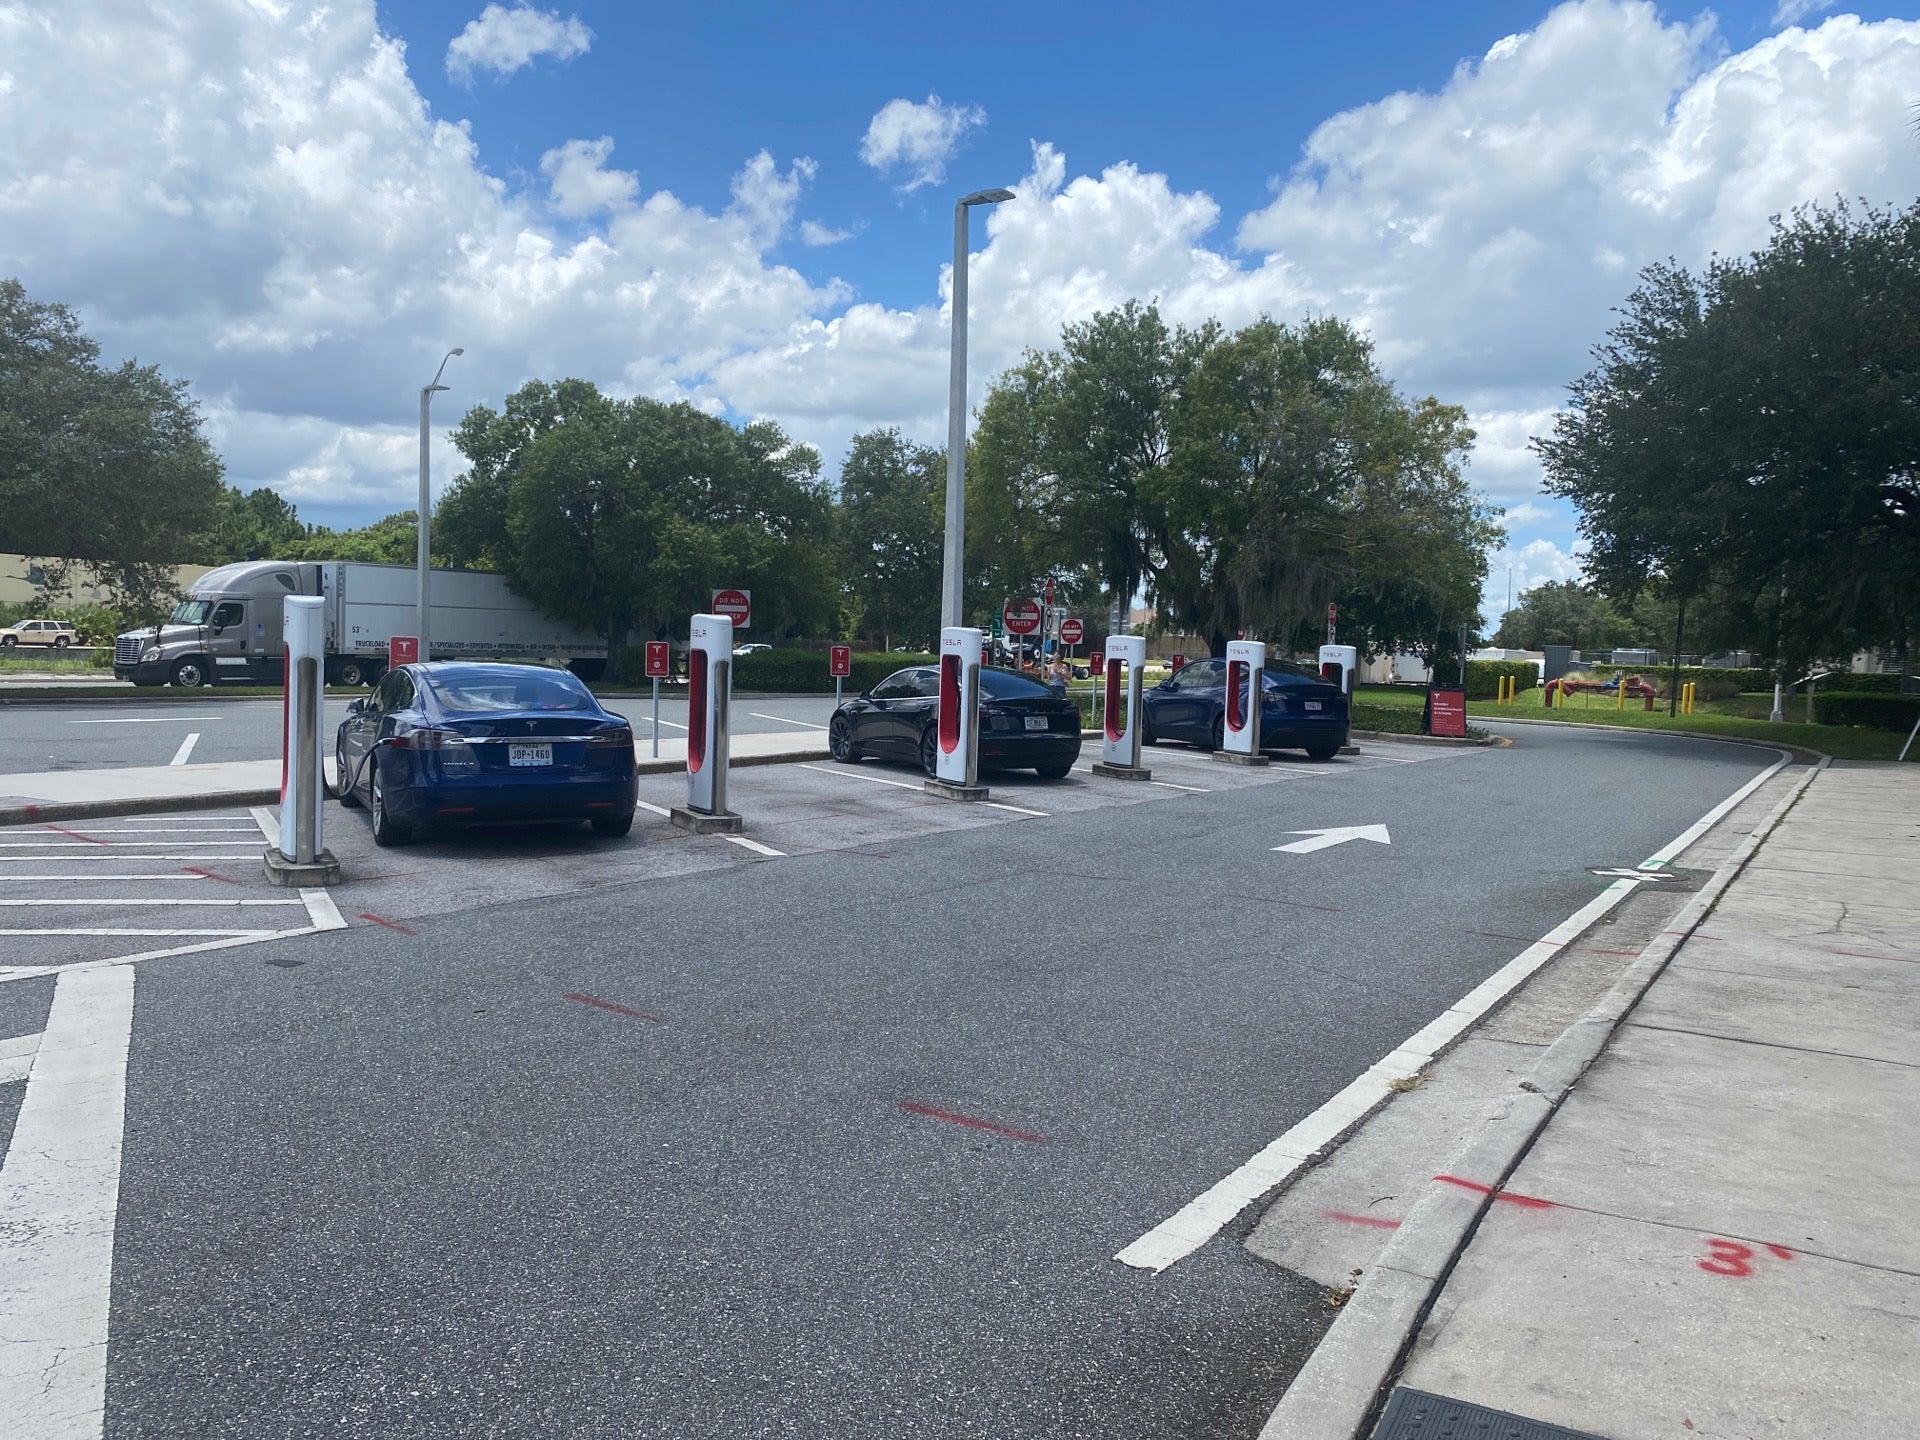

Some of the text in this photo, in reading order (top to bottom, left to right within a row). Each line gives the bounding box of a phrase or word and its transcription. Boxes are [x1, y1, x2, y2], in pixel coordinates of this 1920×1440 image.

[355, 640, 386, 648] TRUCKLOAD
[942, 638, 962, 646] TESLA
[512, 749, 550, 760] JDP-1460
